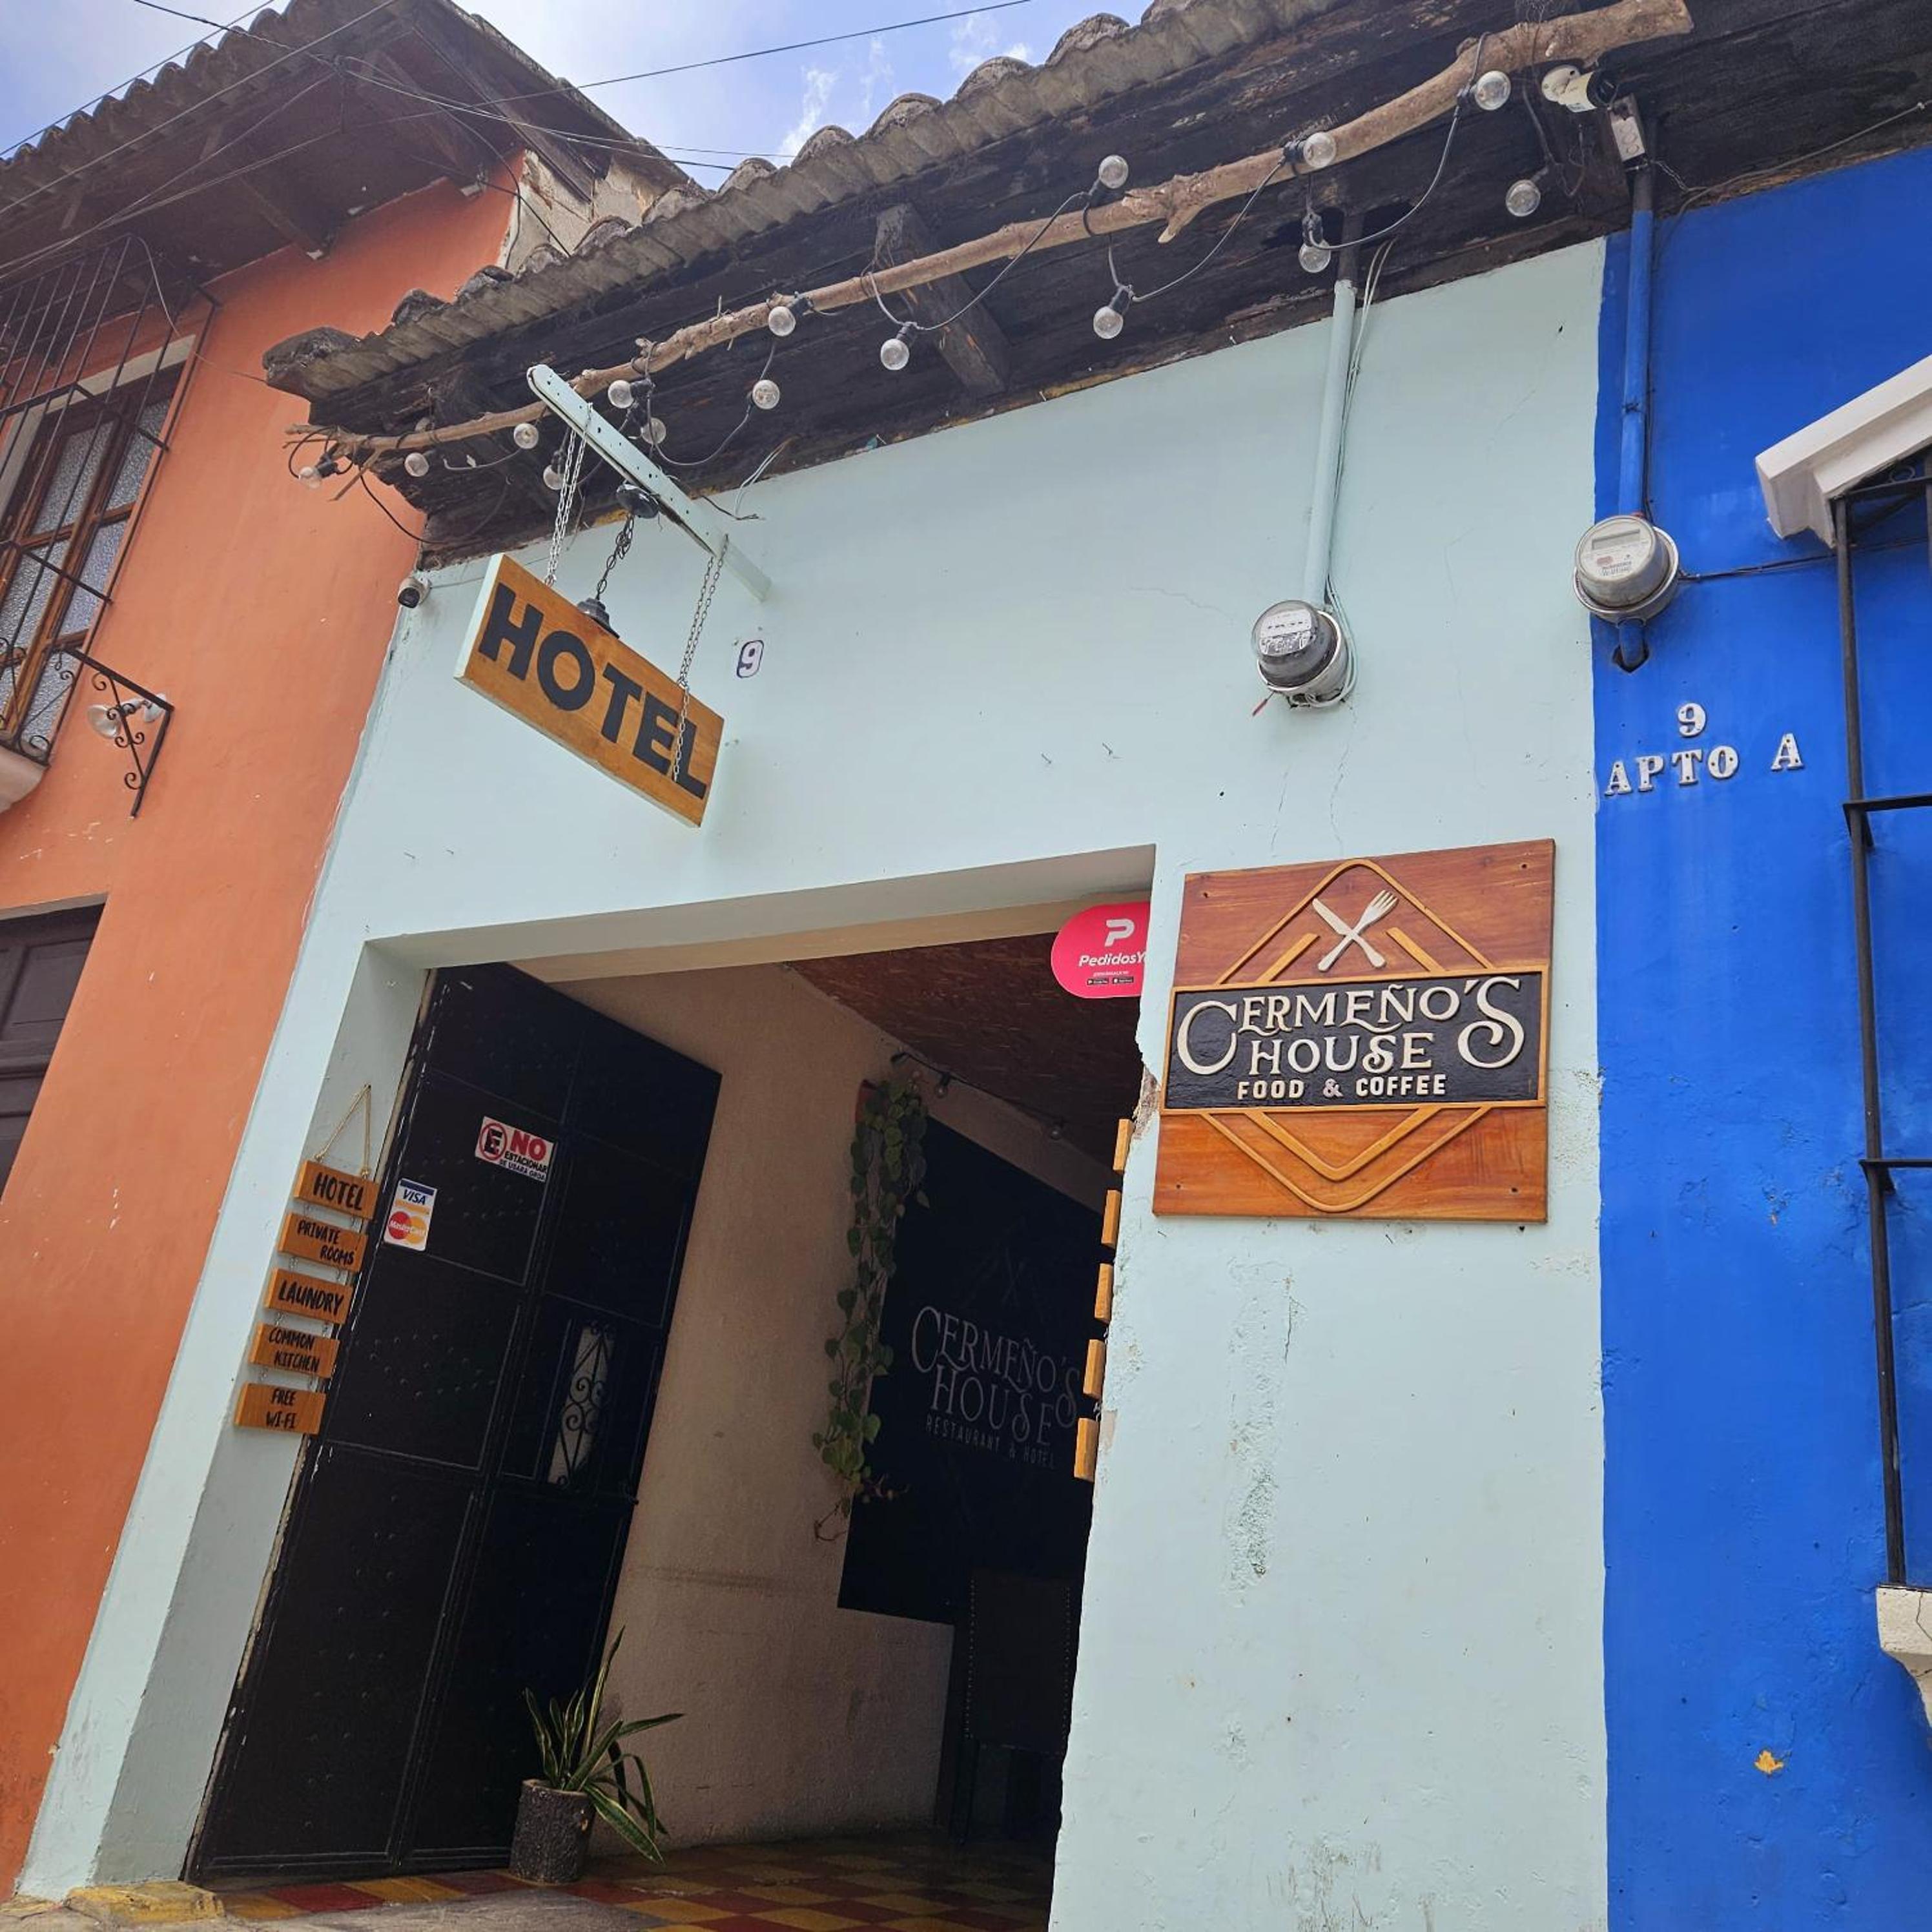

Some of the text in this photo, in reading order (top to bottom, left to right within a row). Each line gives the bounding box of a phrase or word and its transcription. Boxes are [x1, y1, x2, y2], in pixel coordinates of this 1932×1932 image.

[736, 639, 765, 679] 9
[478, 582, 706, 799] HOTEL
[1678, 703, 1706, 737] 9
[1605, 733, 1805, 796] APTO A
[1177, 976, 1525, 1076] CERMEÑO'S
[1248, 1032, 1434, 1076] HOUSE
[1237, 1073, 1447, 1100] FOOD & COFFEE
[504, 1151, 547, 1173] ESTACIONAR
[511, 1129, 547, 1161] NO
[313, 1172, 364, 1211] HOTEL
[403, 1189, 426, 1206] VISA
[297, 1219, 340, 1244] PRIVATE
[320, 1245, 355, 1266] ROOMS
[278, 1279, 345, 1315] LAUNDRY
[269, 1326, 315, 1350] COMMON
[273, 1351, 320, 1373] KITCHEN
[911, 1306, 1080, 1428] CERMEÑO'S
[271, 1388, 296, 1406] FREE
[930, 1364, 1053, 1445] HOUSE
[266, 1410, 296, 1429] WI-FI
[925, 1413, 1001, 1454] RESTAURANT
[1023, 1443, 1056, 1470] HOTEL
